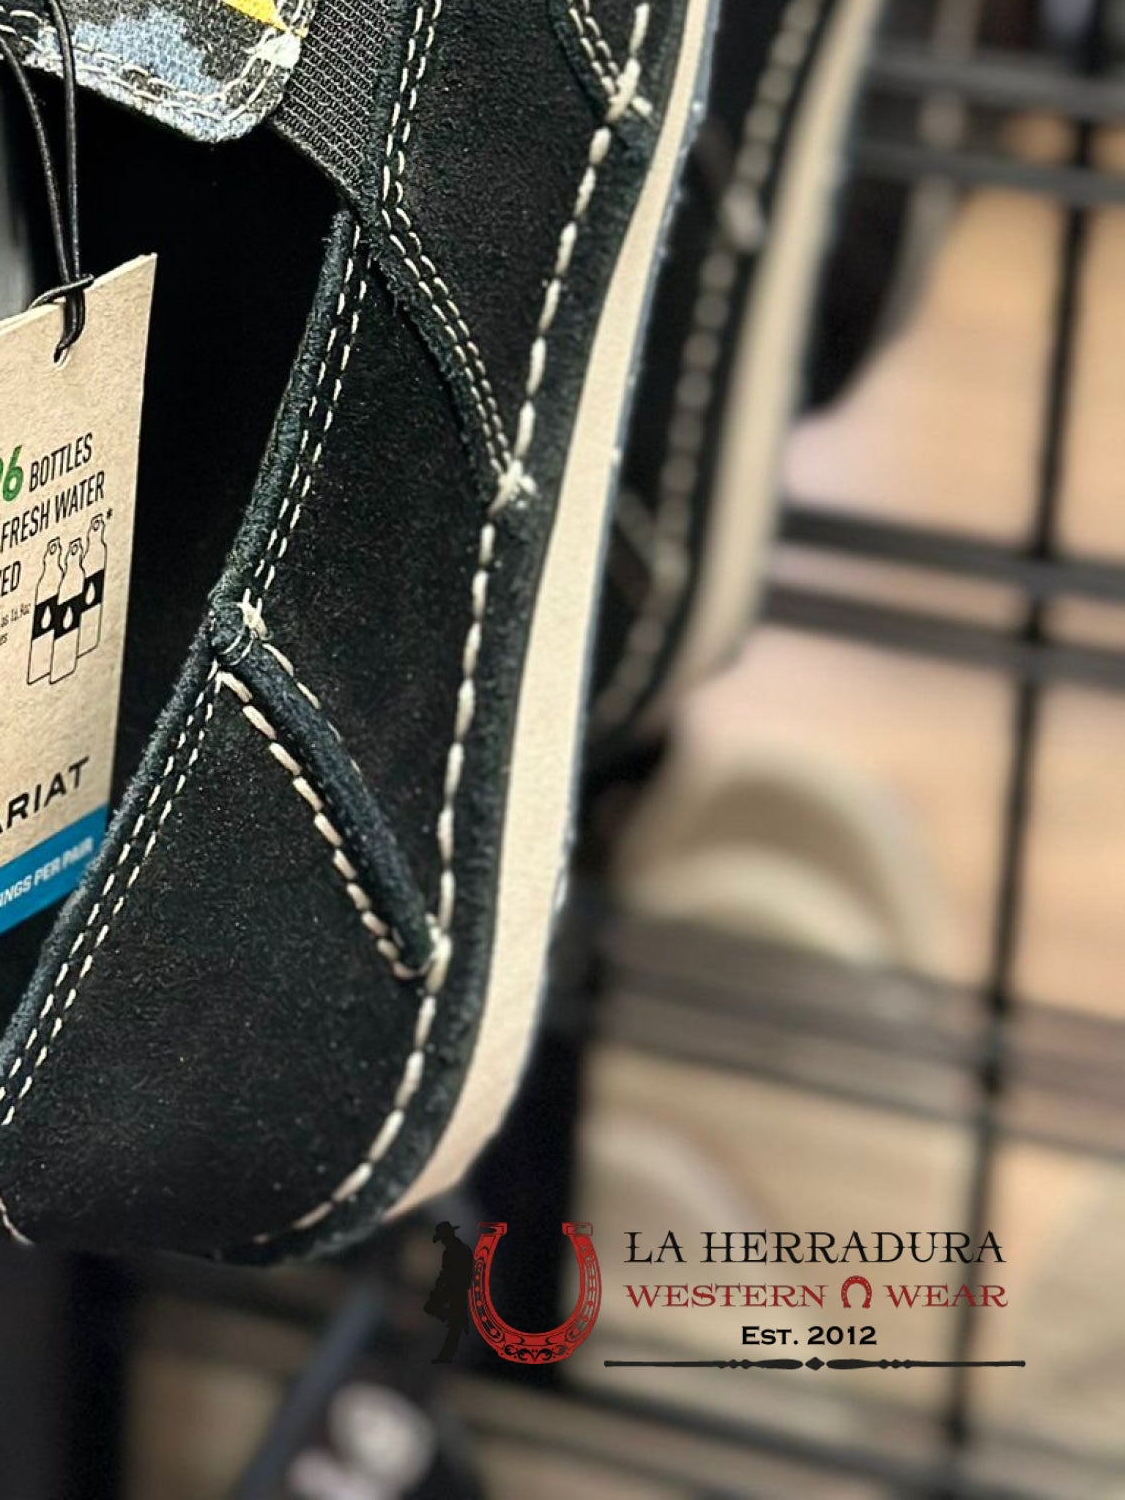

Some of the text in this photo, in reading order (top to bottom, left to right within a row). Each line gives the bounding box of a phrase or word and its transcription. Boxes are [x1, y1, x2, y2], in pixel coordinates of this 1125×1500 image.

[29, 432, 93, 493] BOTTLES
[0, 506, 50, 554] FRESH
[54, 470, 106, 522] WATER
[33, 856, 61, 886] PER
